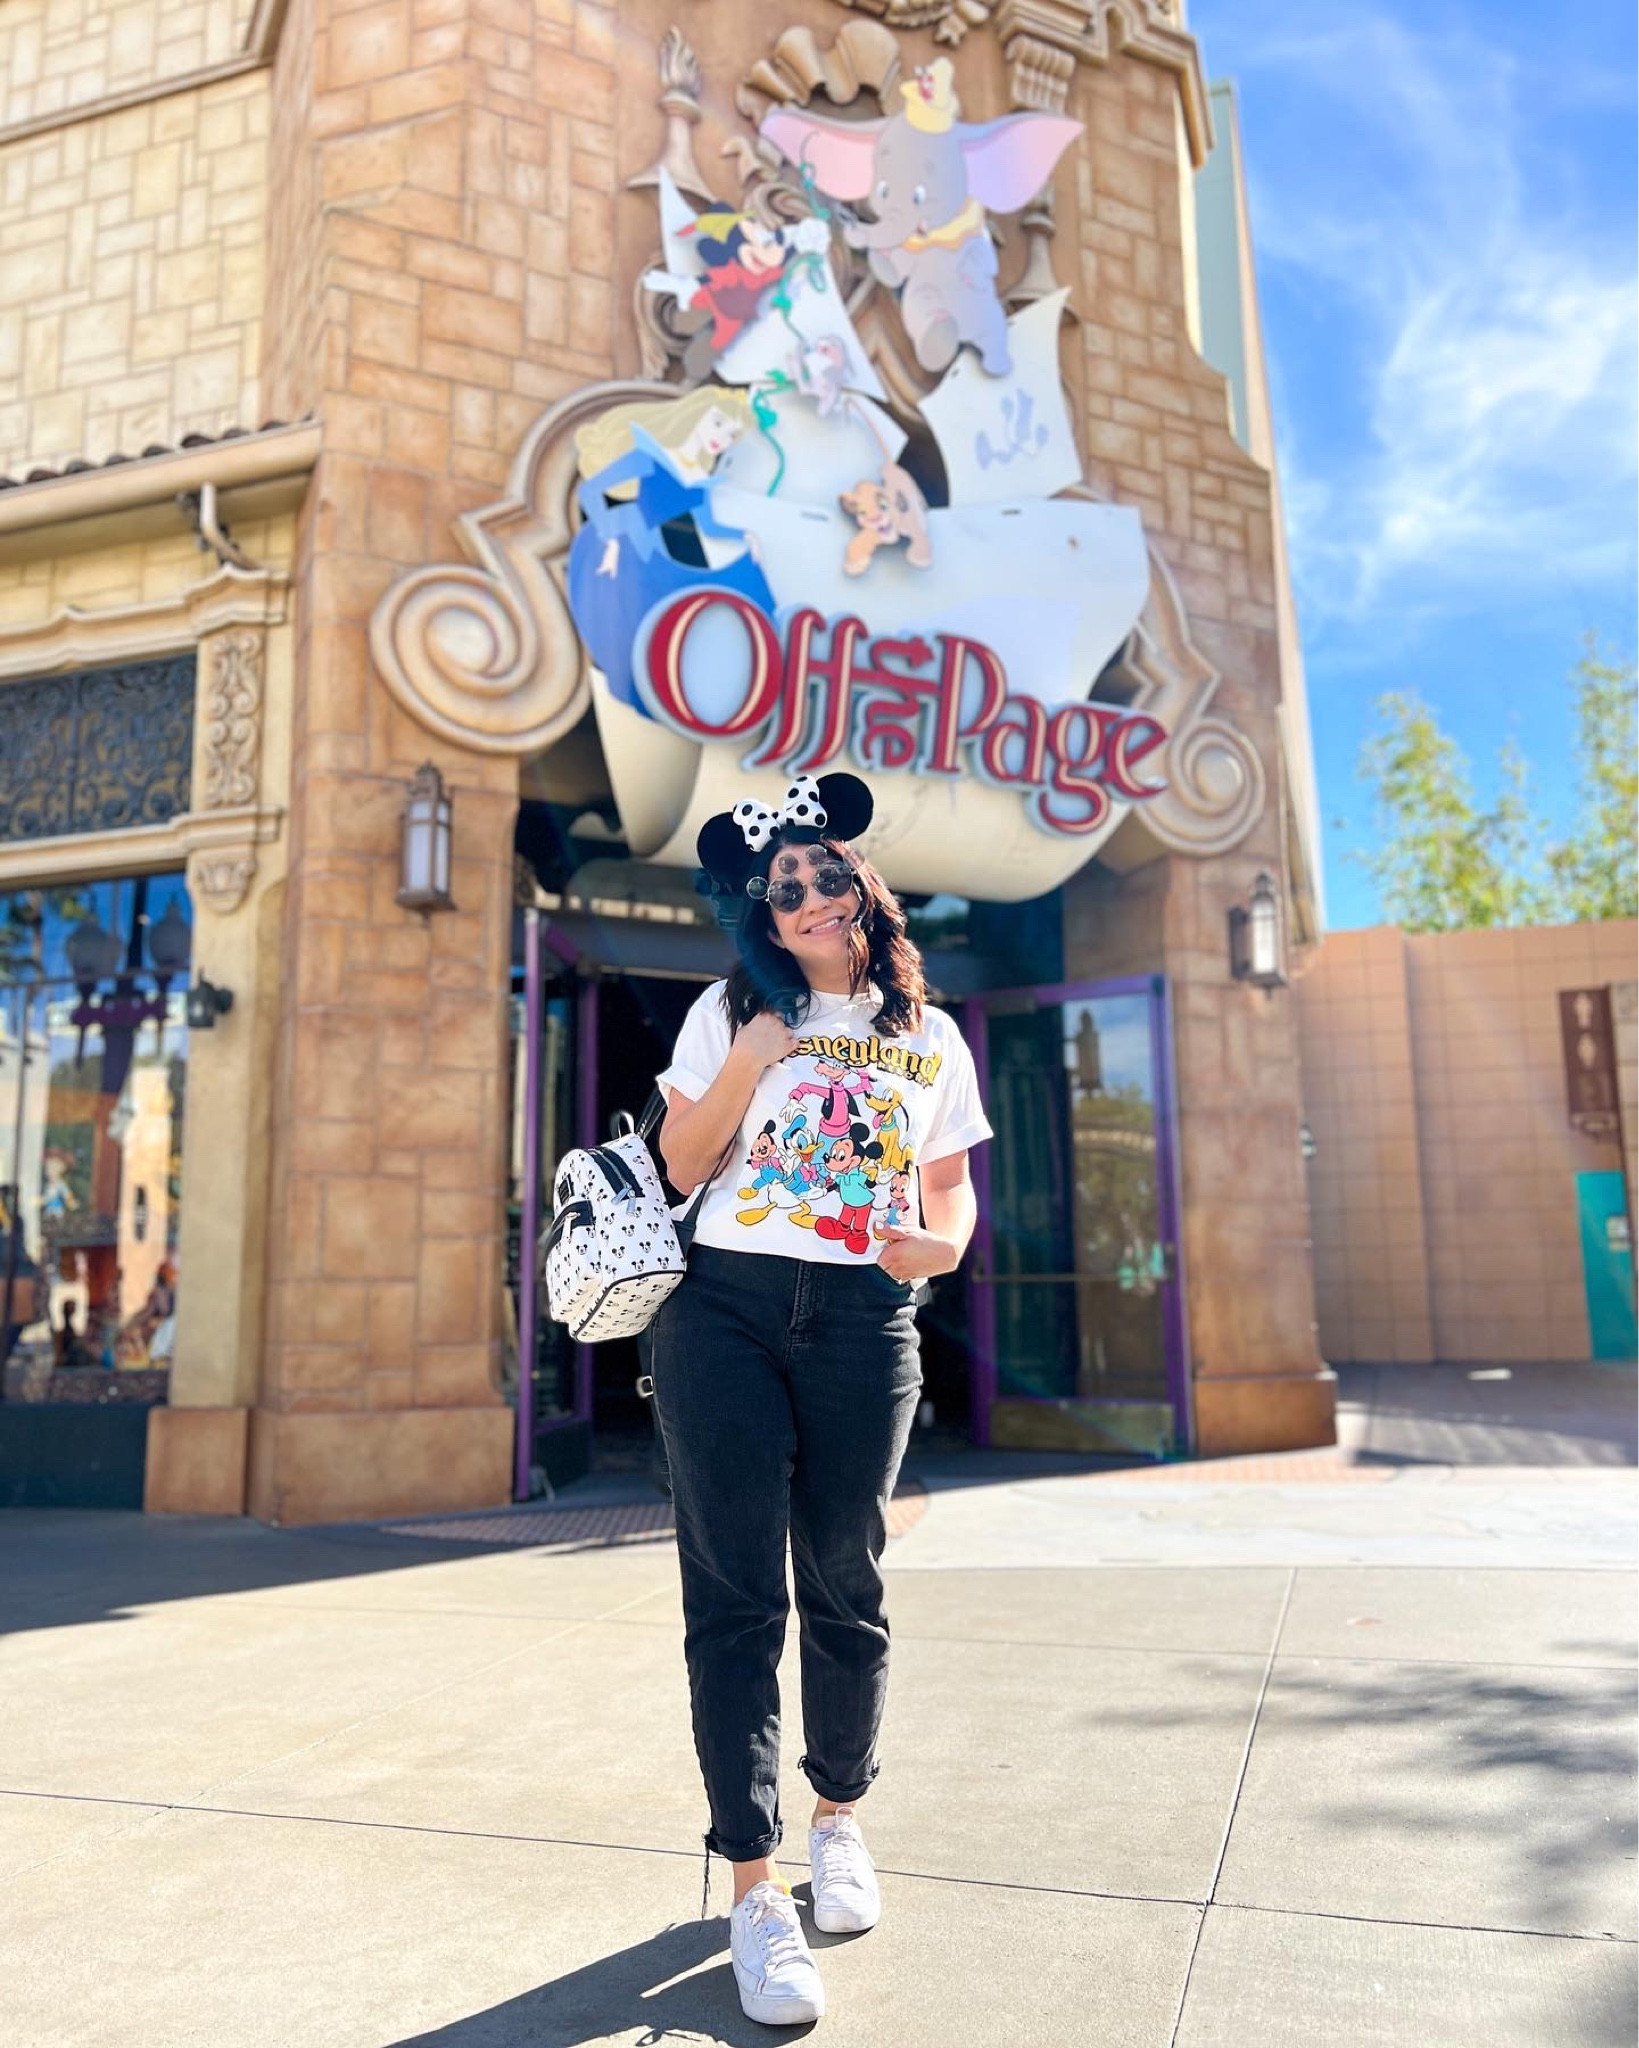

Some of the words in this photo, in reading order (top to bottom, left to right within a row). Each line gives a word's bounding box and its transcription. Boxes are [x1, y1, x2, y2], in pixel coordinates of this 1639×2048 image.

[647, 590, 868, 770] Off
[926, 632, 1169, 833] Page
[788, 1034, 943, 1087] sneyland
